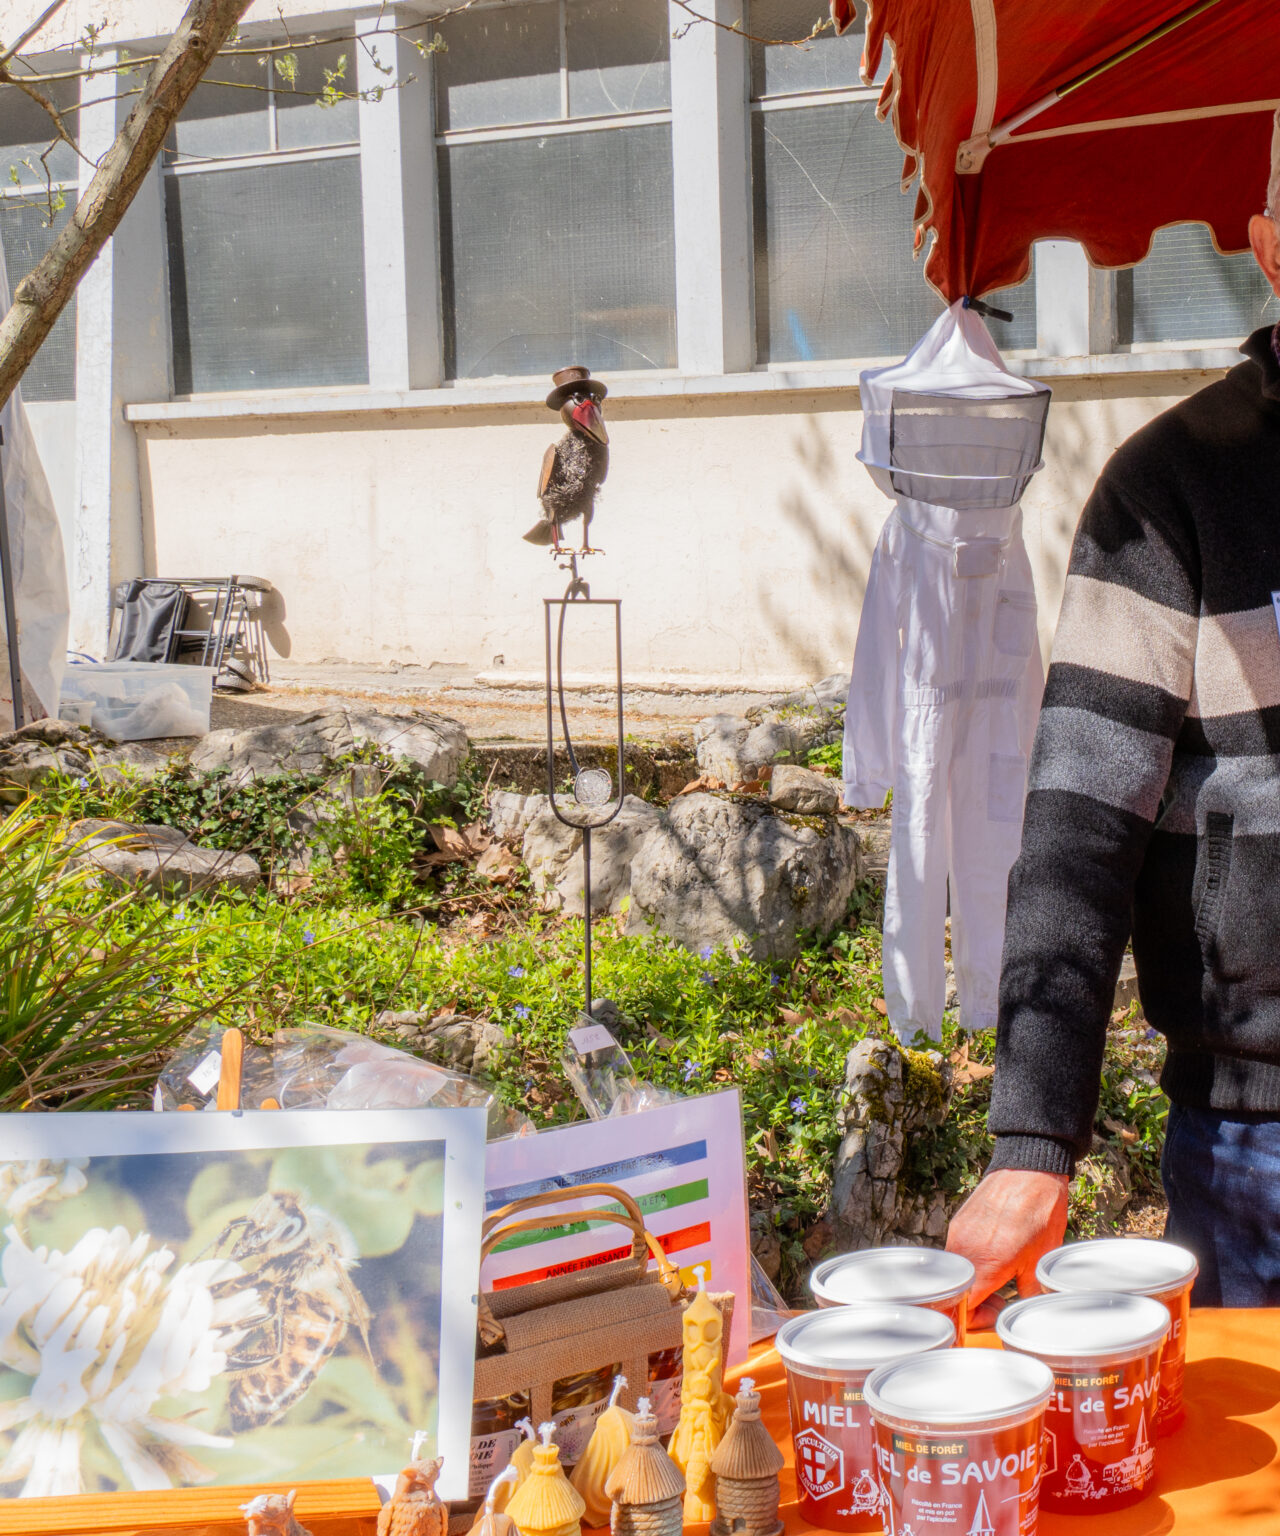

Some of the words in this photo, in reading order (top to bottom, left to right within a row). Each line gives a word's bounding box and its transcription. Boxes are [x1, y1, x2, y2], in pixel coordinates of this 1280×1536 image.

[649, 1194, 660, 1205] ET
[546, 1262, 578, 1279] ANNÉE
[581, 1251, 626, 1271] FINISSANT
[1075, 1378, 1089, 1387] DE
[1090, 1374, 1120, 1386] FORÊT
[1079, 1396, 1105, 1413] de
[1113, 1371, 1160, 1410] SAVO
[803, 1400, 860, 1428] MIEL
[478, 1439, 496, 1450] DE
[895, 1439, 915, 1453] MIEL
[916, 1444, 929, 1454] DE
[931, 1443, 964, 1455] FORÊT
[907, 1465, 932, 1484] de
[941, 1443, 1037, 1485] SAVOIE
